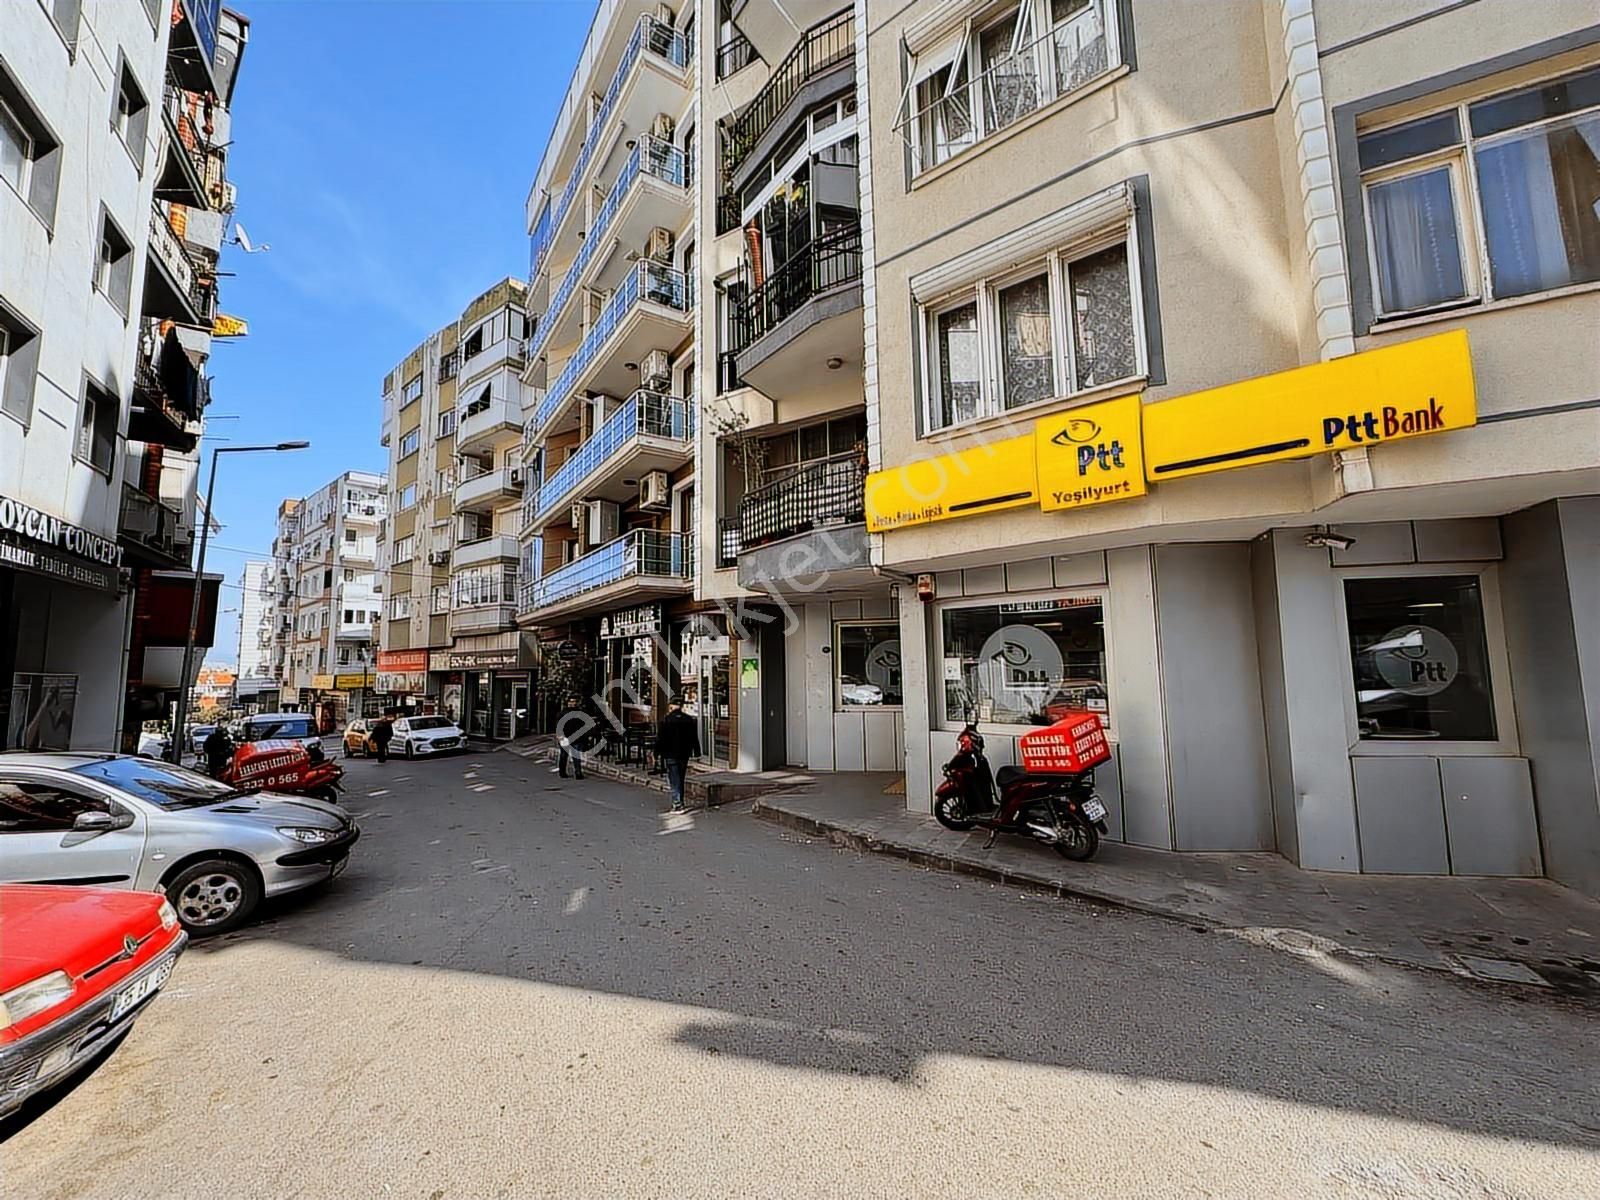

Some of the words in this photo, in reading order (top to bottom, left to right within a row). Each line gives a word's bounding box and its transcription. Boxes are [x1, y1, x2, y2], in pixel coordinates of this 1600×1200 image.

[1077, 440, 1125, 476] Ptt
[1052, 480, 1131, 504] Yeşilyurt
[65, 526, 124, 568] CONCEPT
[1410, 660, 1447, 682] Ptt
[1023, 746, 1051, 758] LEZZET
[278, 772, 299, 785] 565
